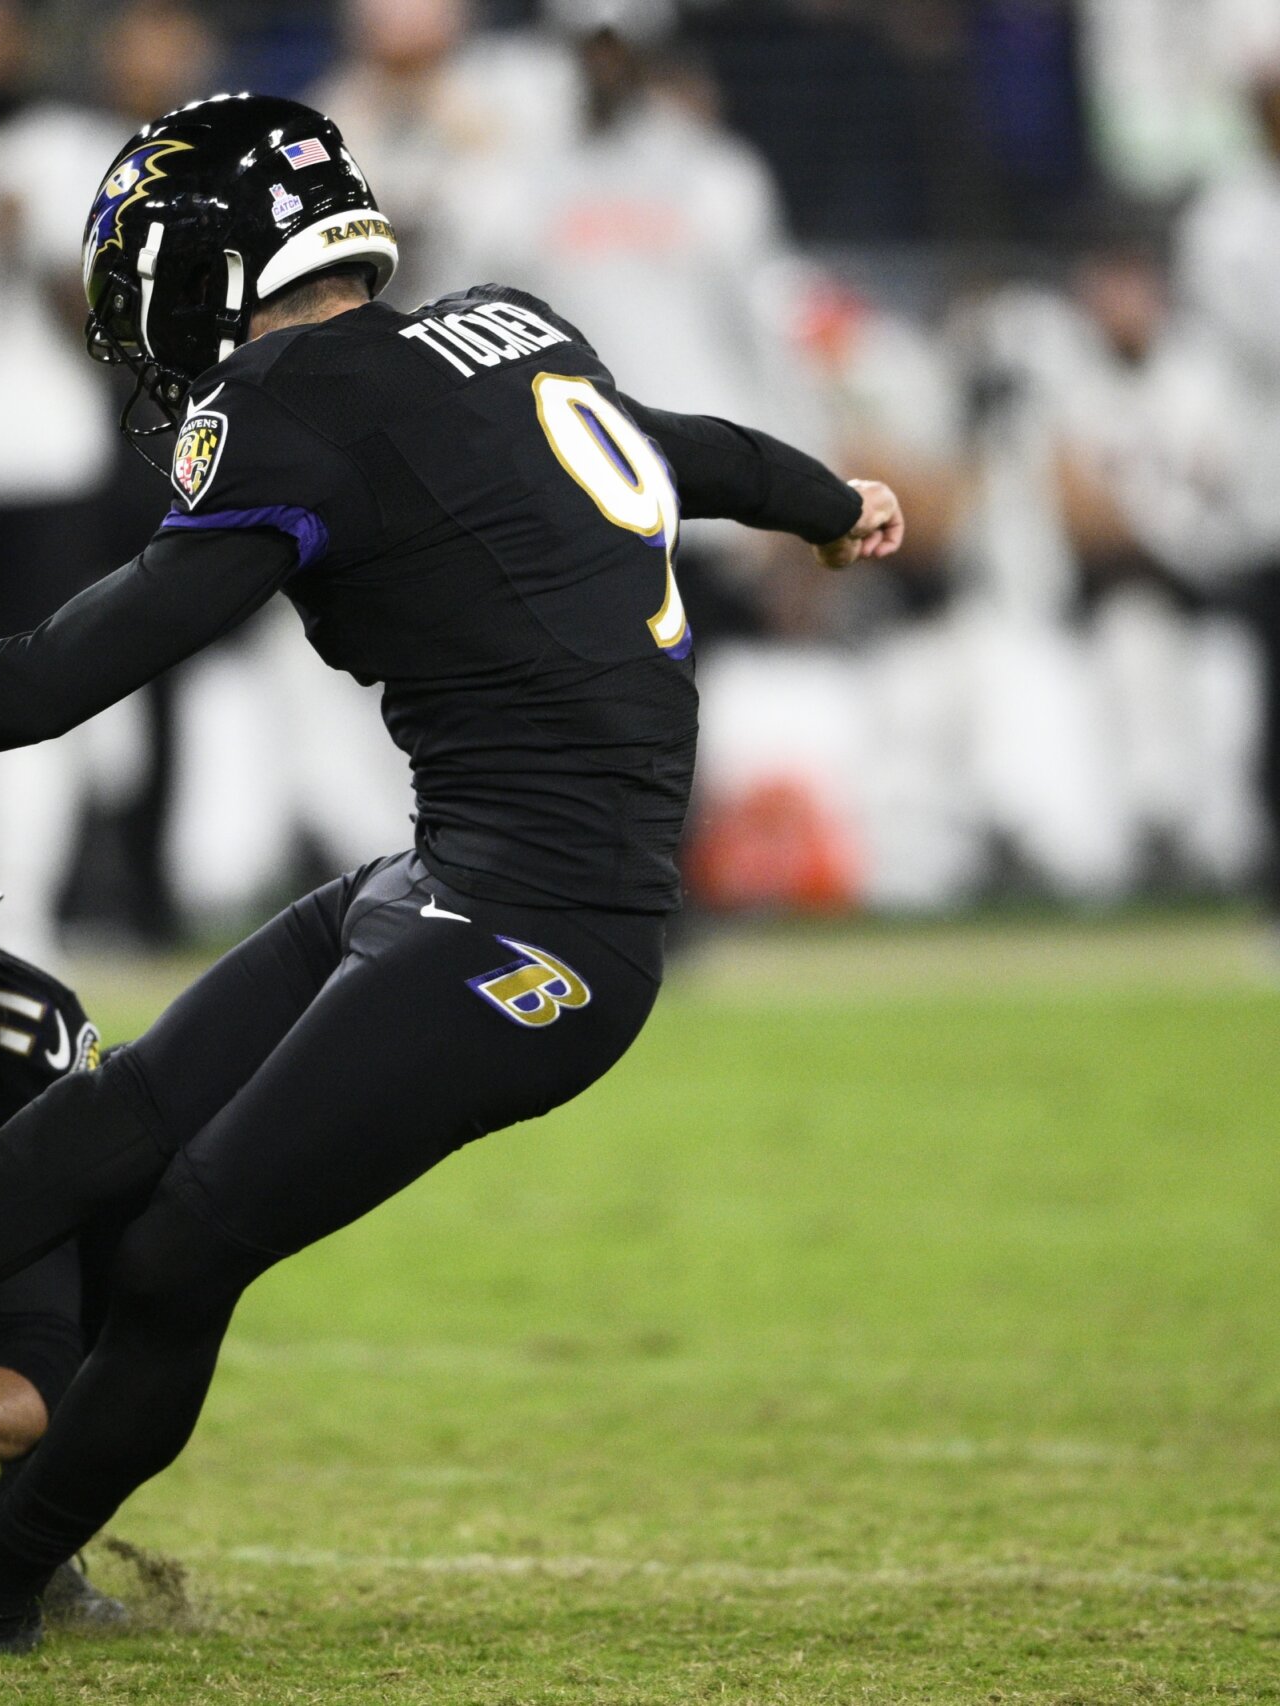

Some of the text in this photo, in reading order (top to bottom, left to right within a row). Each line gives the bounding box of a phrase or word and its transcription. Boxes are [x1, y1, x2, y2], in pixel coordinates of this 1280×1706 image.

[273, 197, 301, 216] CATCH
[319, 219, 397, 248] RAVEN
[398, 302, 572, 378] TUCKER
[531, 371, 693, 660] 9
